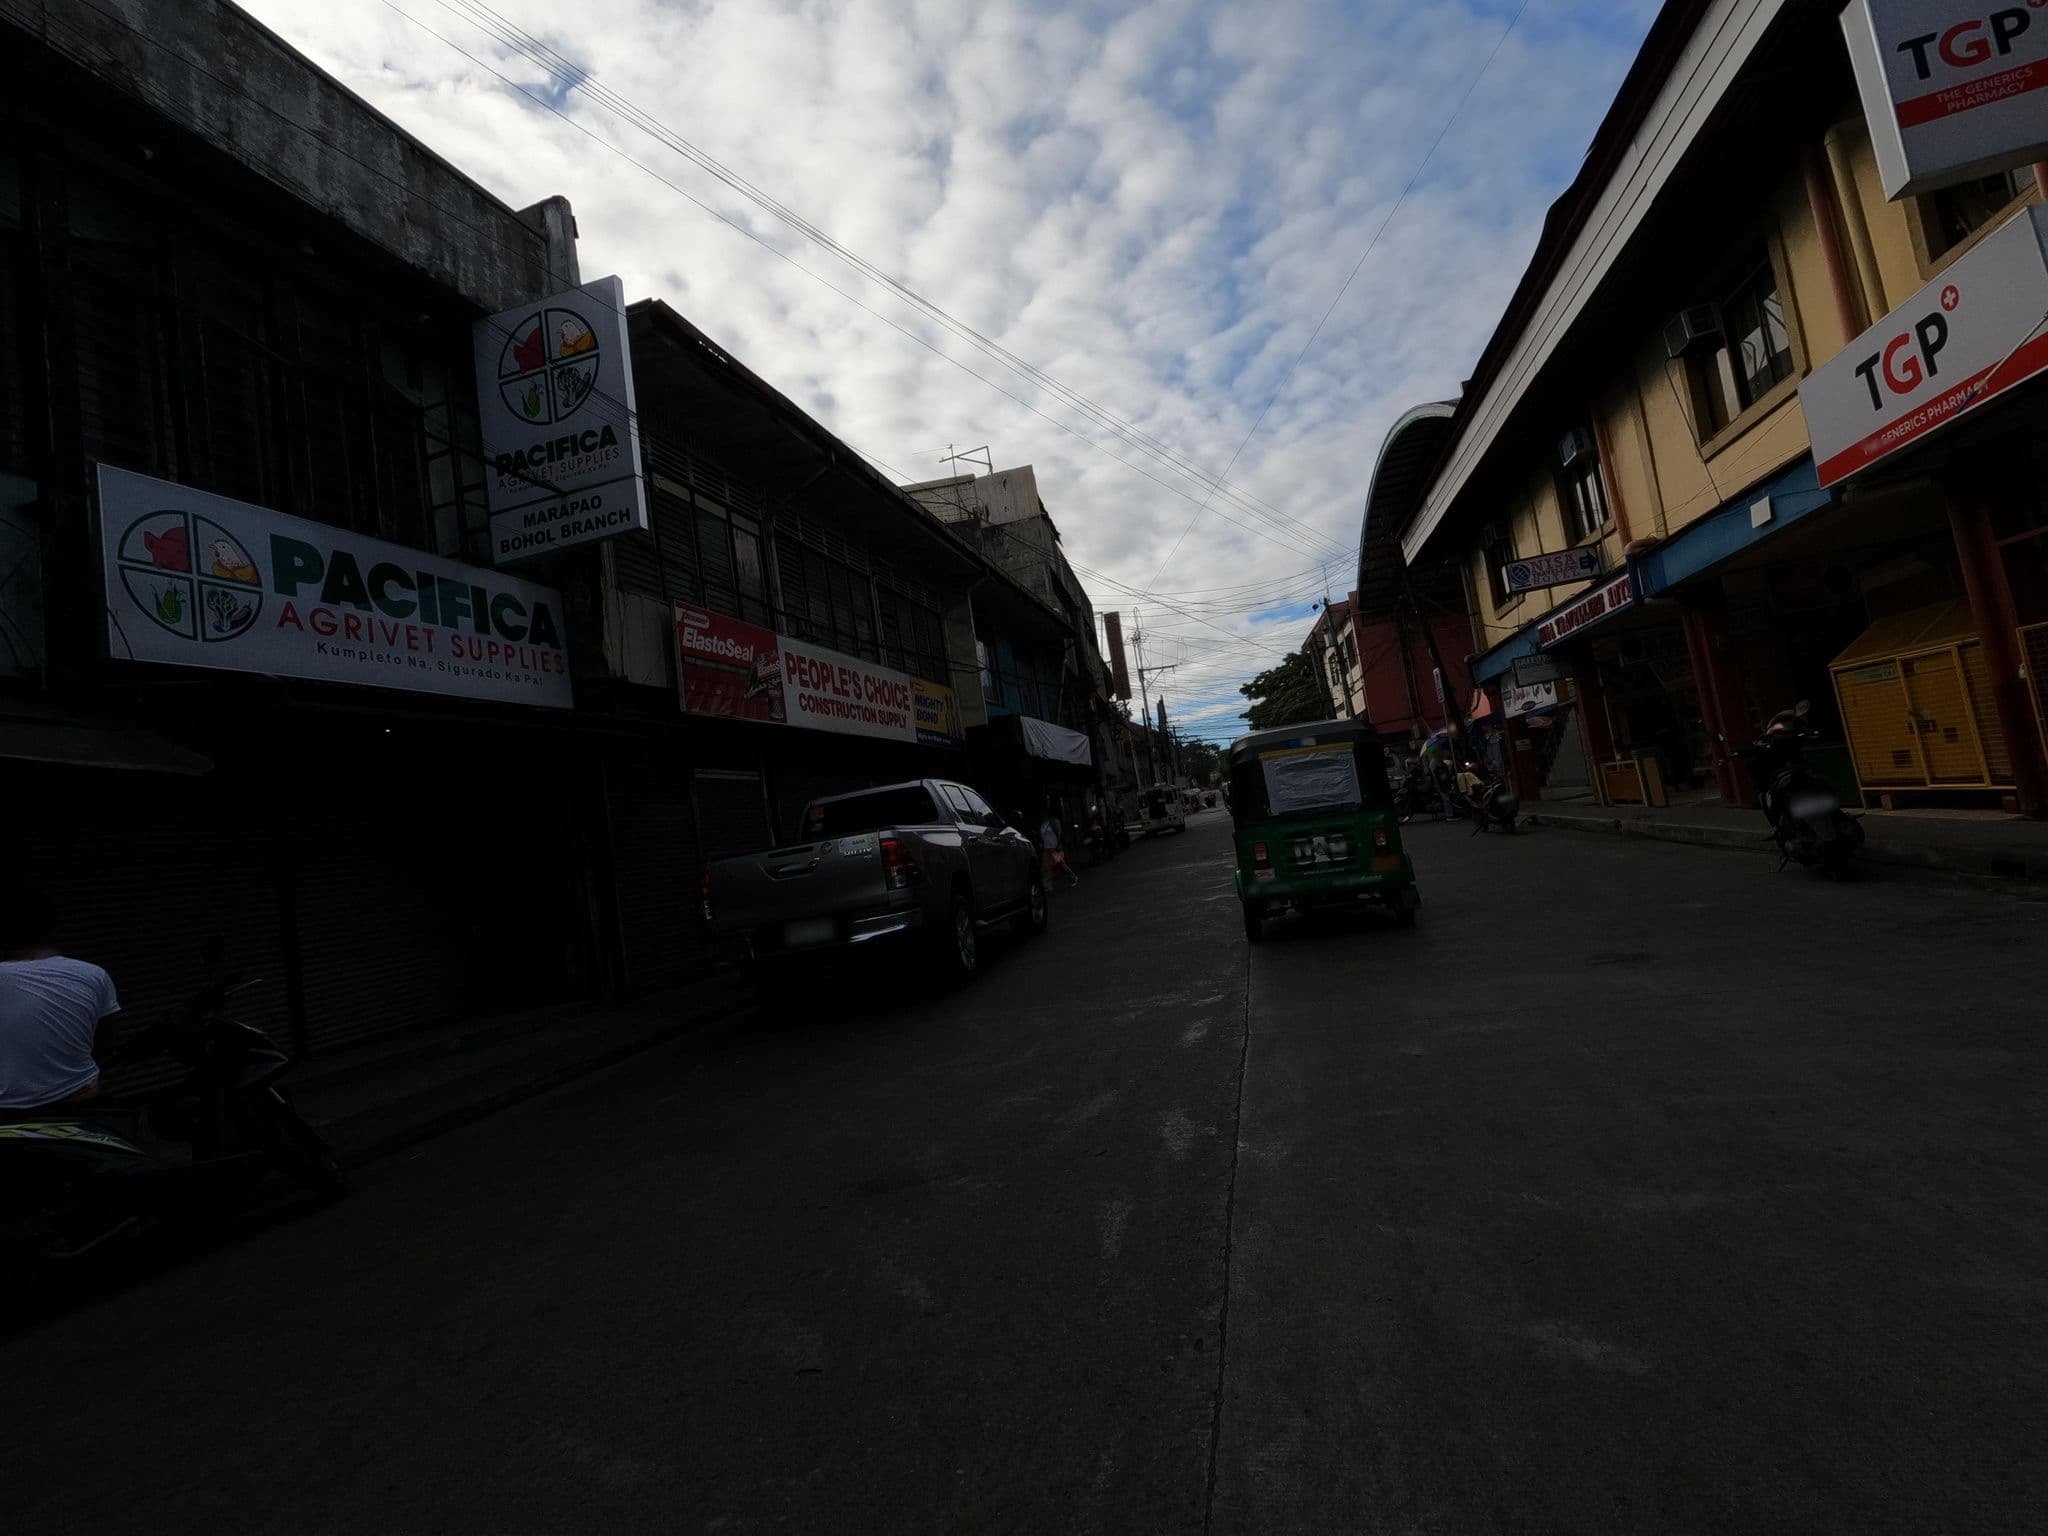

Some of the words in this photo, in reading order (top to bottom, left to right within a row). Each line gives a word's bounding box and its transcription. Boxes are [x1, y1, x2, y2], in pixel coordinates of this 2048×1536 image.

[1897, 7, 2031, 81] TGP
[1936, 88, 1962, 105] THE
[1964, 66, 2034, 95] GENERICS
[1947, 81, 2026, 112] PHARMACY
[1855, 311, 1949, 412] TGP
[495, 424, 618, 478] PACIFICA
[560, 447, 620, 474] SUPPLIES
[500, 528, 556, 554] BOHOL
[561, 507, 631, 540] BRANCH
[523, 494, 602, 528] MARAPAO
[269, 534, 562, 651] PACIFICA
[275, 600, 437, 653] AGRIVET
[450, 634, 566, 675] SUPPLIES
[681, 626, 755, 662] ElastoSeal
[316, 641, 403, 666] Kumpleto
[436, 659, 502, 681] Sigurado
[504, 671, 522, 683] Ka
[784, 651, 862, 700] PEOPLE'S
[863, 674, 911, 712] CHOICE
[798, 692, 878, 724] CONSTRUCTION
[878, 710, 908, 729] SUPPLY
[914, 694, 945, 713] MIGHTY
[916, 710, 939, 725] BOND
